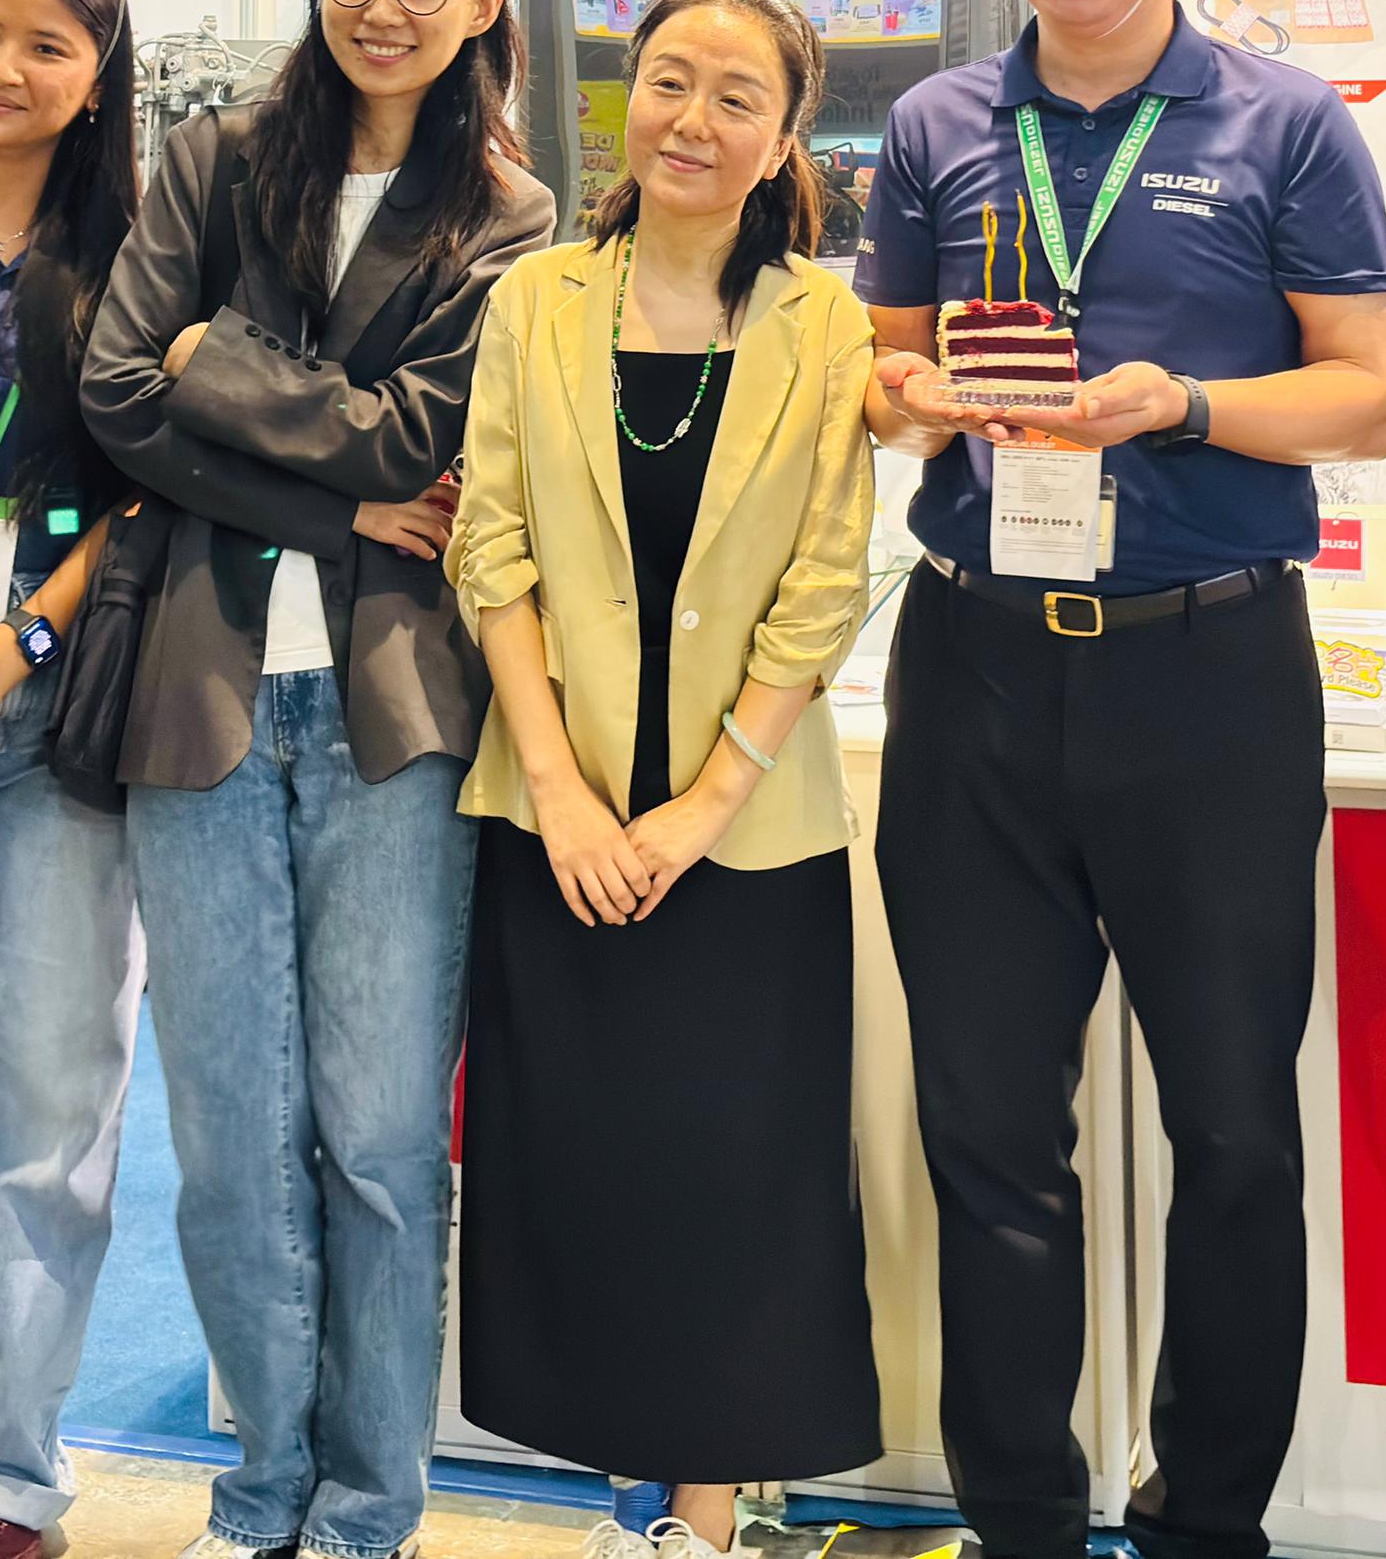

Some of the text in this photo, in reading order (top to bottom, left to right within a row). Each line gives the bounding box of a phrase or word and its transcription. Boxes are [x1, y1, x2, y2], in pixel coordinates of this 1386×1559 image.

[1140, 173, 1220, 195] ISUZU
[1152, 199, 1215, 217] DIESEL
[1318, 538, 1358, 550] SUZU
